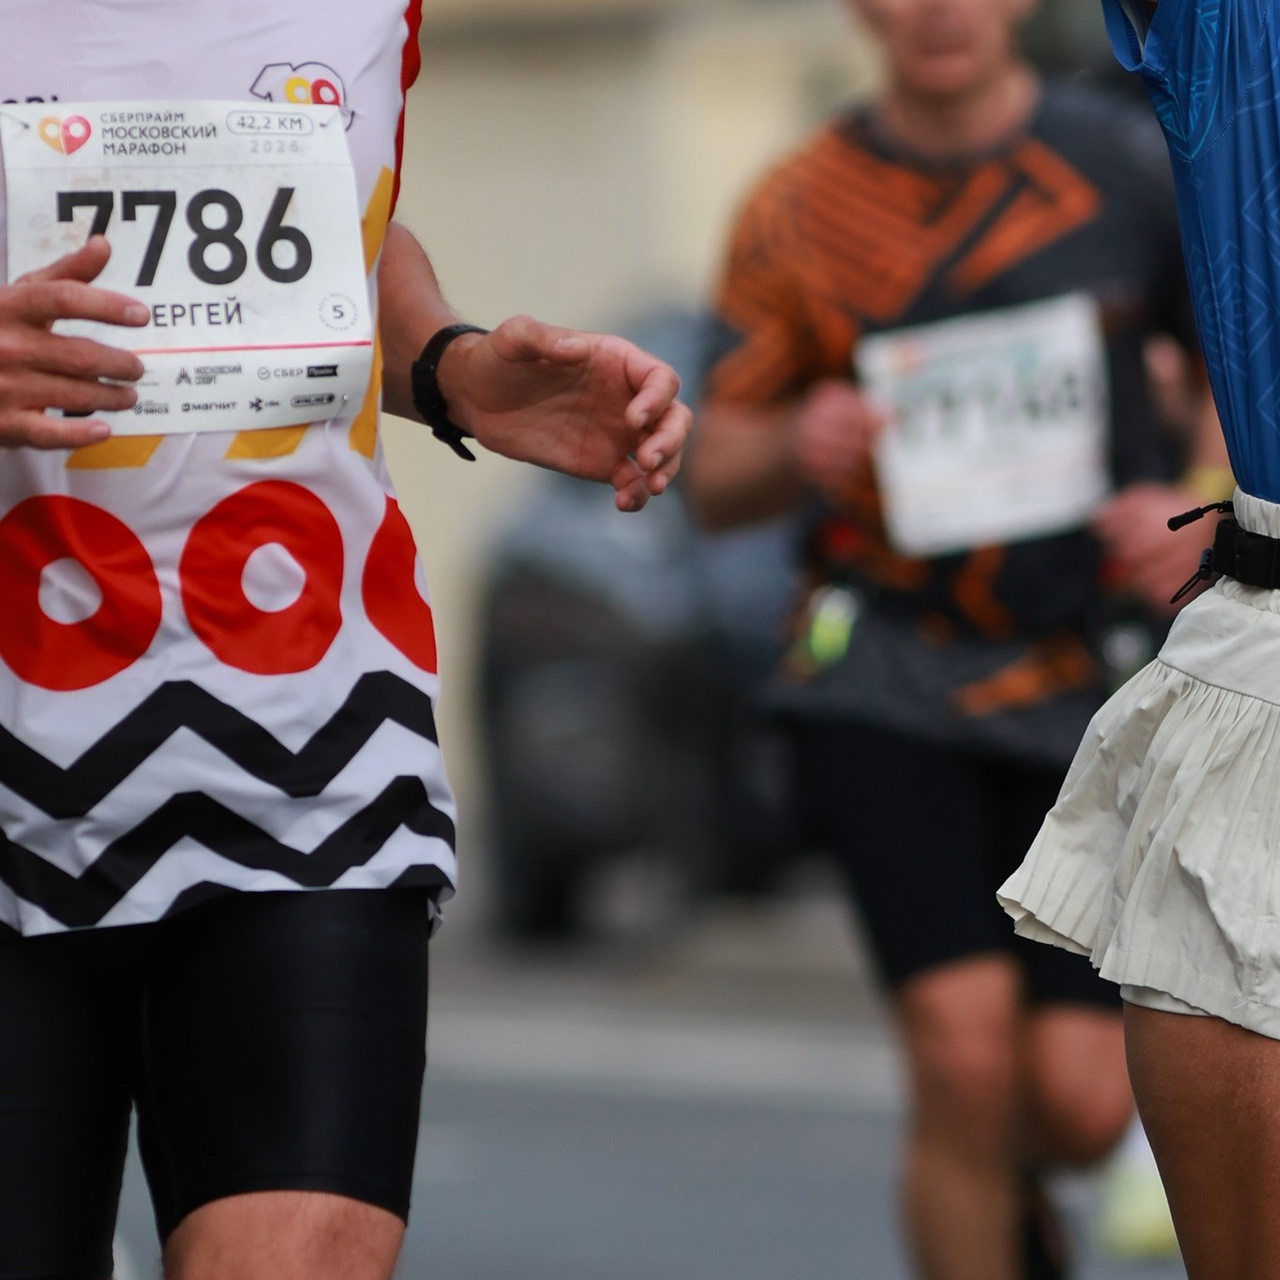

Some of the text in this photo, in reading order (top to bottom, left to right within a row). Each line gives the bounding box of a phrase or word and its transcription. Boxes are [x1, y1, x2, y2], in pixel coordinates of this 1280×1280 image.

[100, 112, 185, 124] СБЕРПРАЙМ
[236, 115, 304, 131] 42,2 КМ
[101, 124, 217, 139] МОСКОВСКИЙ
[102, 142, 186, 156] МАРАФОН
[250, 140, 300, 154] 2026
[56, 186, 312, 287] 7786
[152, 296, 243, 327] ЕРГЕЙ
[332, 305, 344, 319] 5
